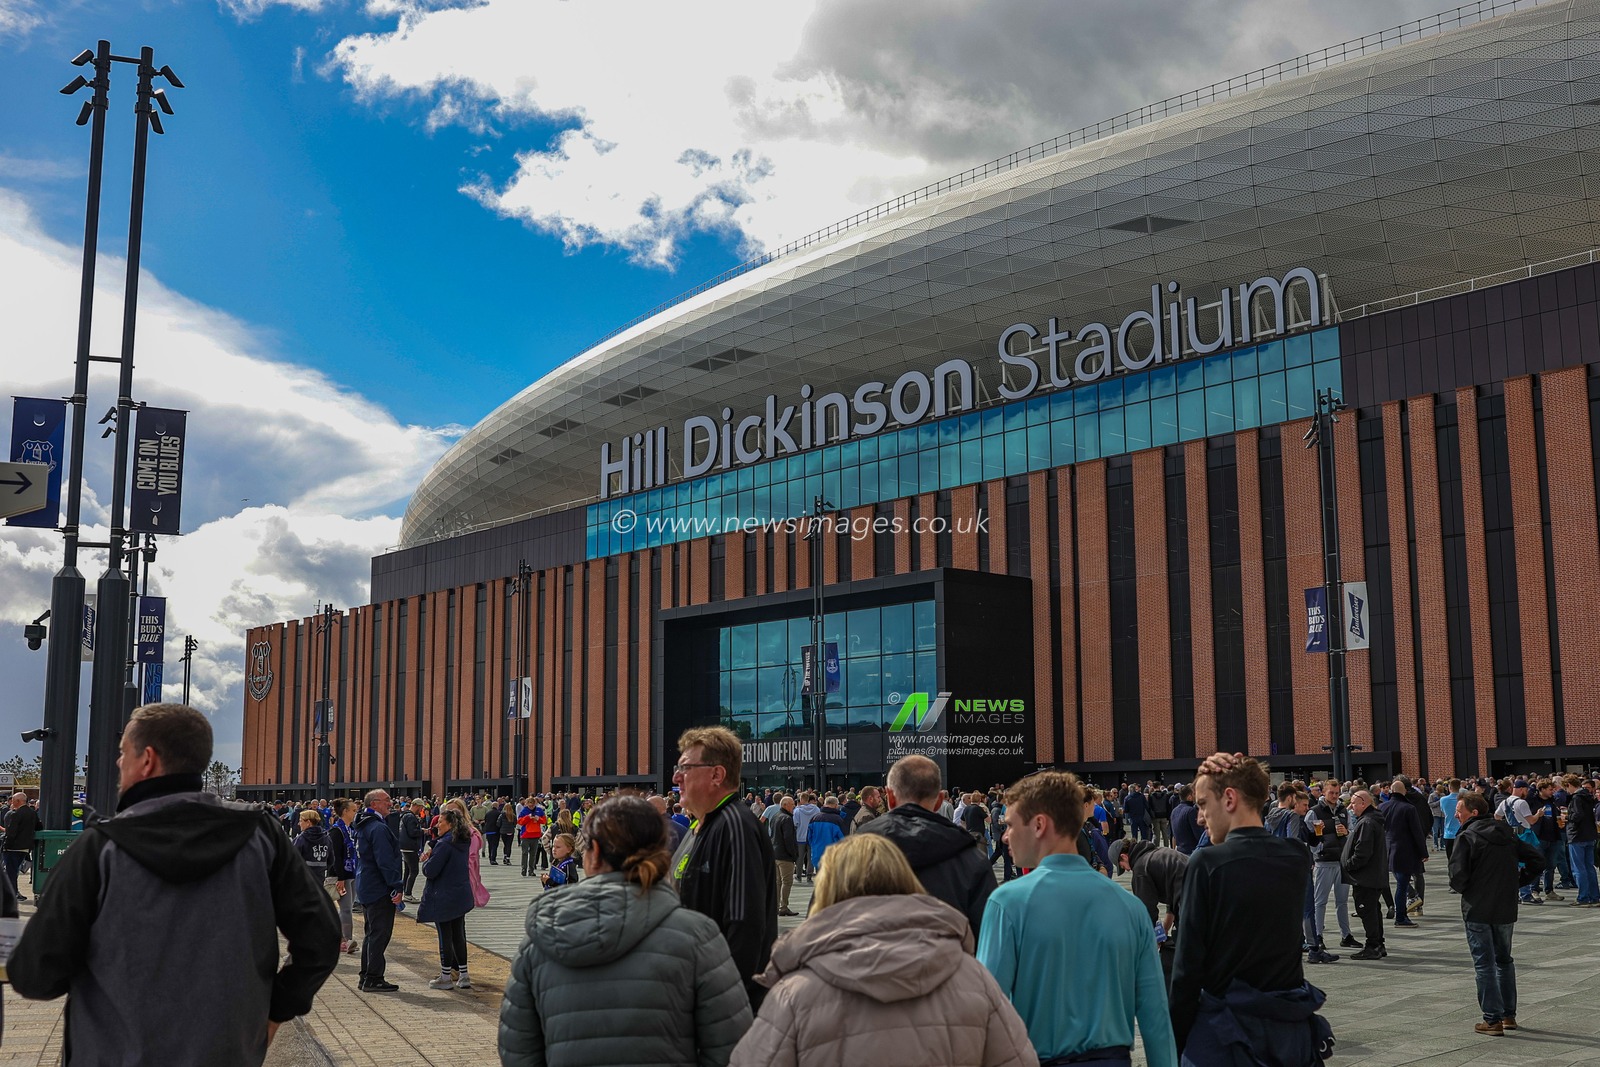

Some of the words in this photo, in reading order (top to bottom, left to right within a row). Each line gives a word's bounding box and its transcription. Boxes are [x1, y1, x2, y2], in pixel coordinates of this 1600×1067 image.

[600, 425, 668, 499] Hill
[683, 358, 976, 481] Dickinson
[997, 266, 1323, 400] Stadium
[139, 439, 159, 456] ON
[159, 435, 181, 471] BLUES
[136, 457, 158, 490] COME
[157, 472, 178, 496] YOU
[141, 615, 159, 624] THIS
[1308, 606, 1321, 616] THIS
[1308, 615, 1325, 625] BUD'S
[1352, 595, 1361, 635] Budweiser
[82, 607, 94, 648] Budweiser
[140, 625, 163, 633] BUD'S
[1308, 624, 1324, 634] BLUE
[139, 634, 161, 643] BLUE
[741, 742, 770, 763] ERTON
[772, 740, 813, 762] OFFICIAL
